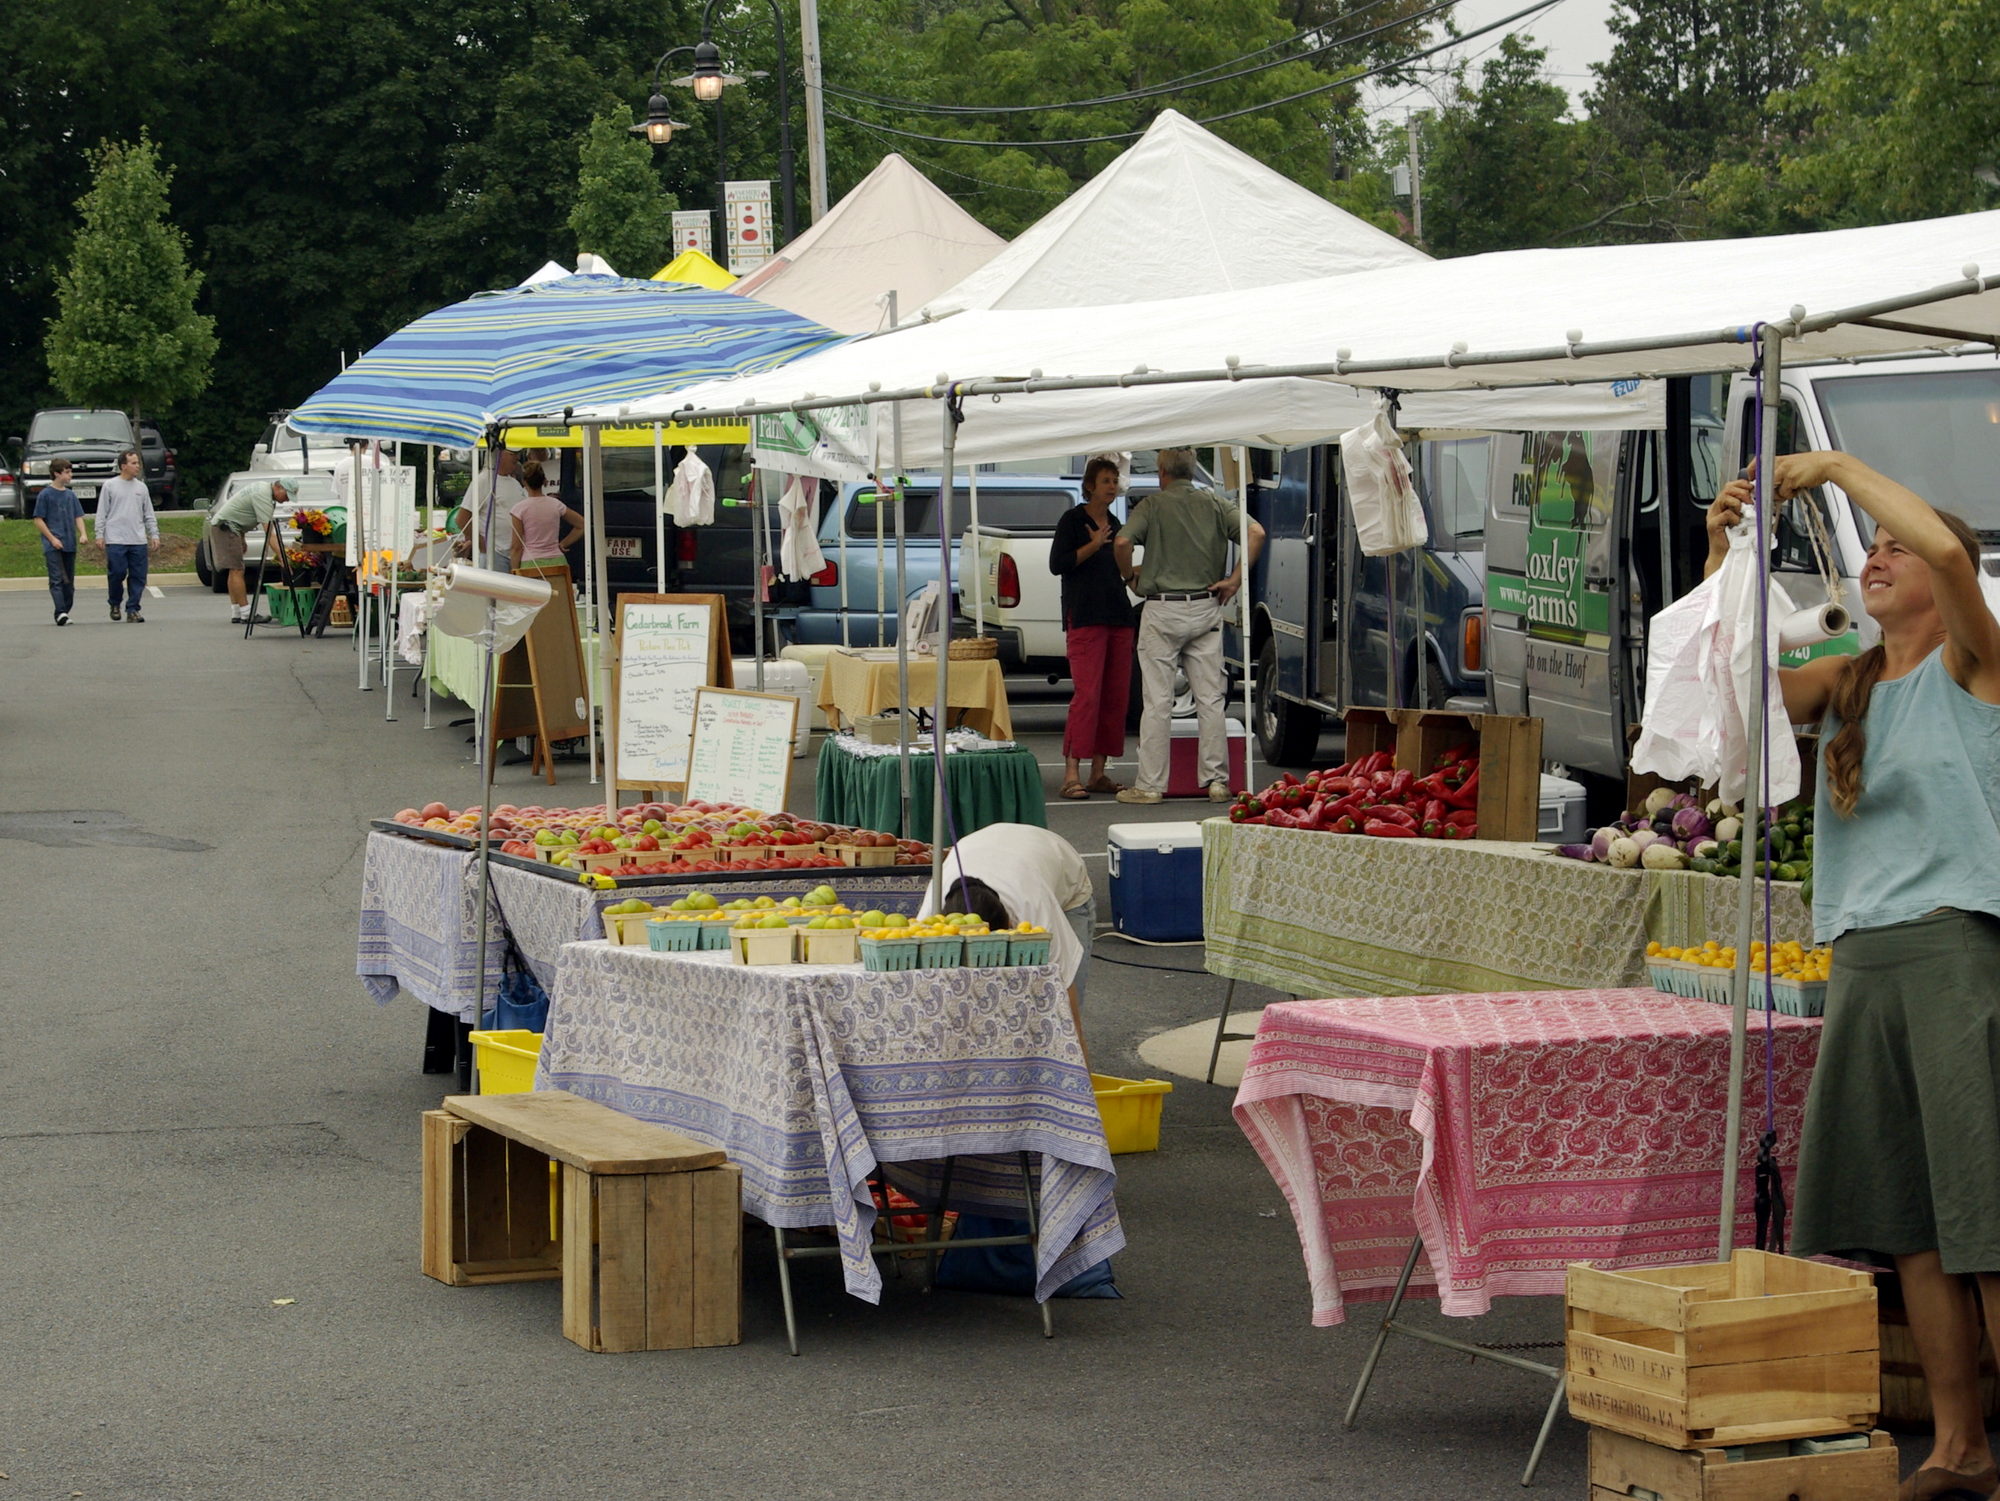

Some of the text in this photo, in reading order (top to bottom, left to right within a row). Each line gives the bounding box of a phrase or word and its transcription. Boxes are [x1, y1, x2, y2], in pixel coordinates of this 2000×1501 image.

[607, 539, 636, 548] FARM
[611, 547, 631, 556] USE
[1526, 537, 1580, 598] oxley
[677, 612, 700, 630] Farm
[1526, 586, 1578, 628] arms
[1536, 654, 1547, 672] on
[1549, 649, 1562, 676] the
[1564, 653, 1589, 689] Hoof
[1612, 1352, 1635, 1373] AND
[1642, 1360, 1675, 1381] LEAF
